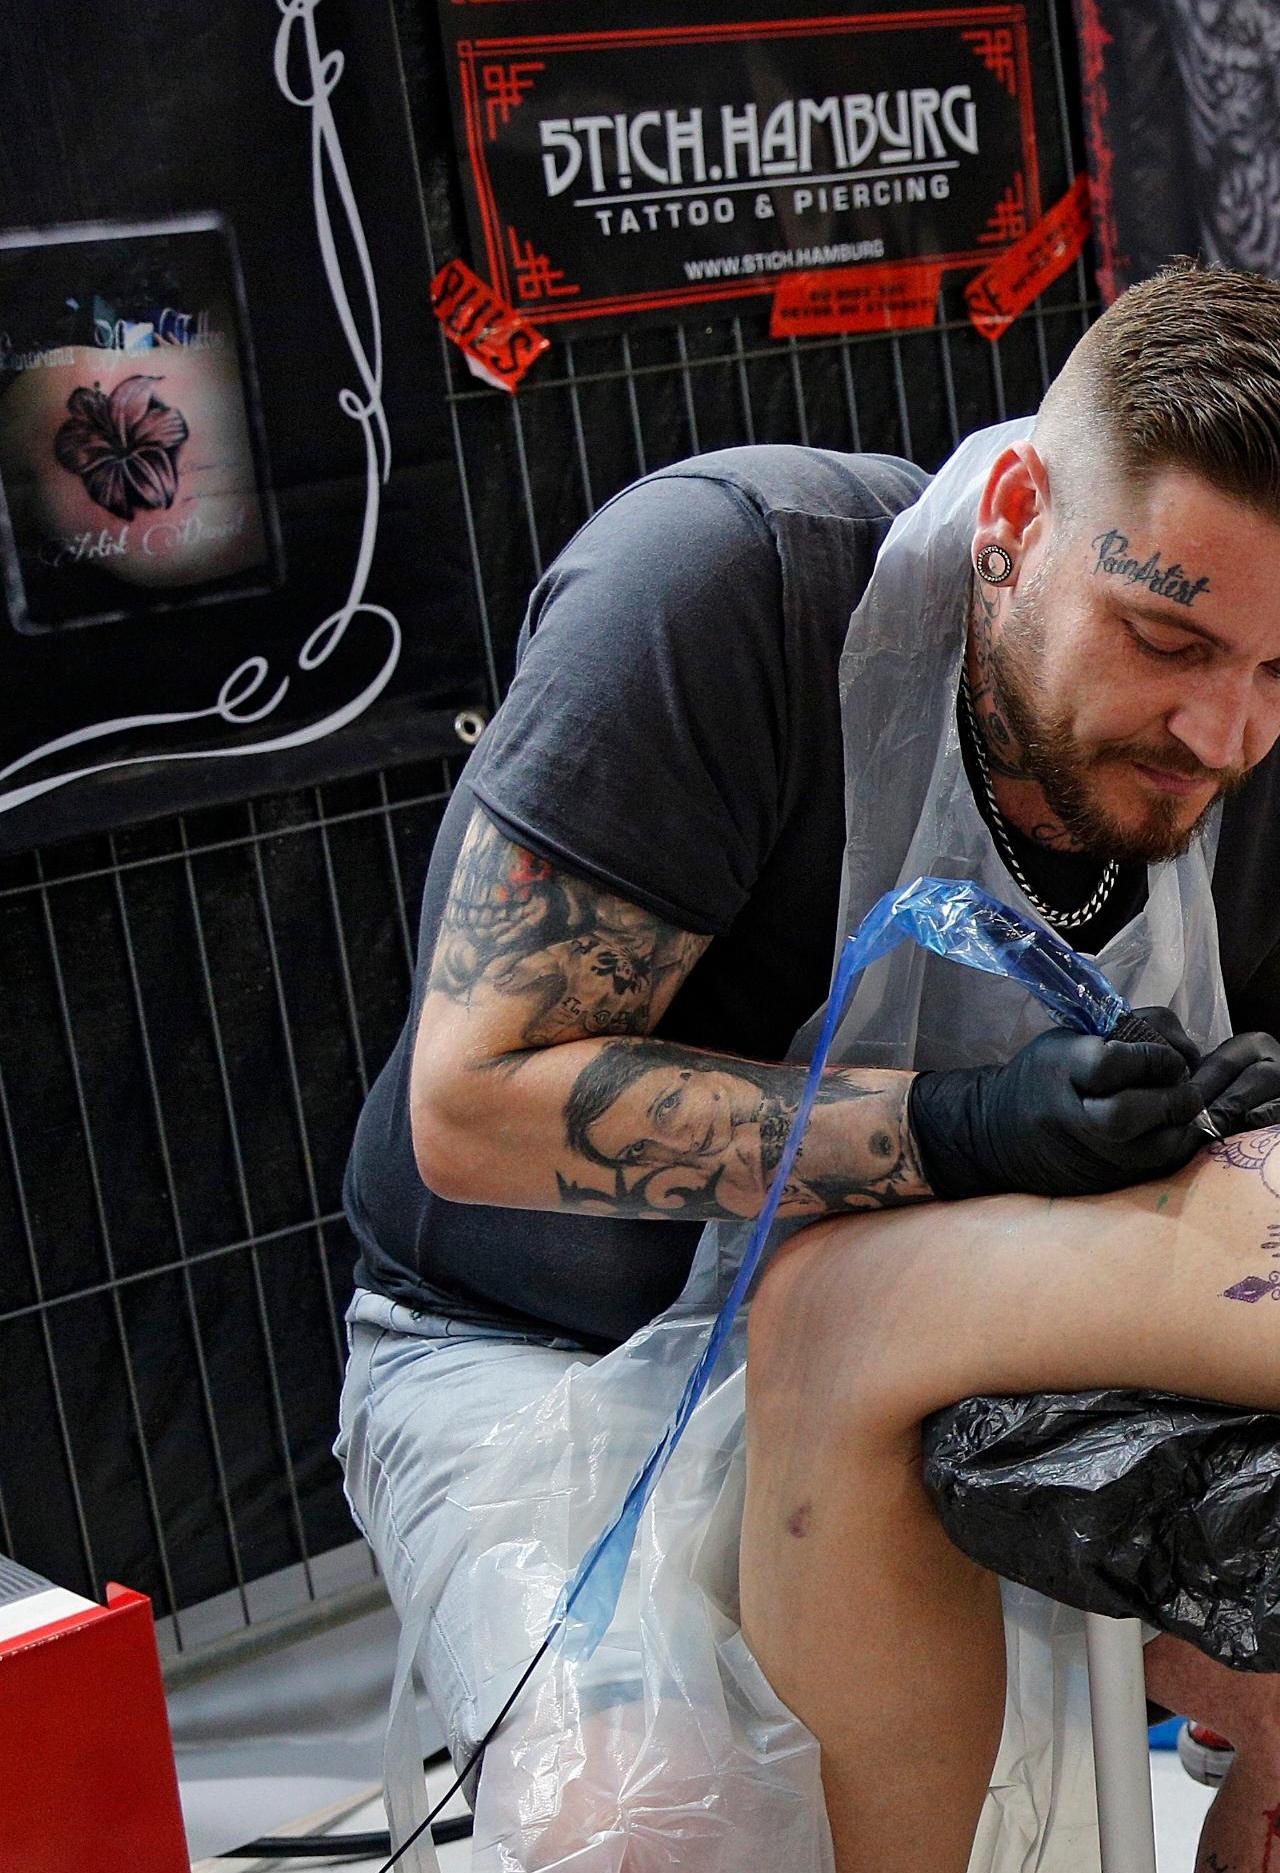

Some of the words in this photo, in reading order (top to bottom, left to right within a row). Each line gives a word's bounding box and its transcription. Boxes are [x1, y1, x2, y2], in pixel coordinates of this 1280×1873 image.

[539, 84, 979, 197] STICH.HAMBURG
[595, 198, 735, 236] TATTOO
[755, 193, 775, 220] &
[793, 174, 950, 216] PIERCING
[683, 239, 885, 281] WWW.STICH.HAMBURG
